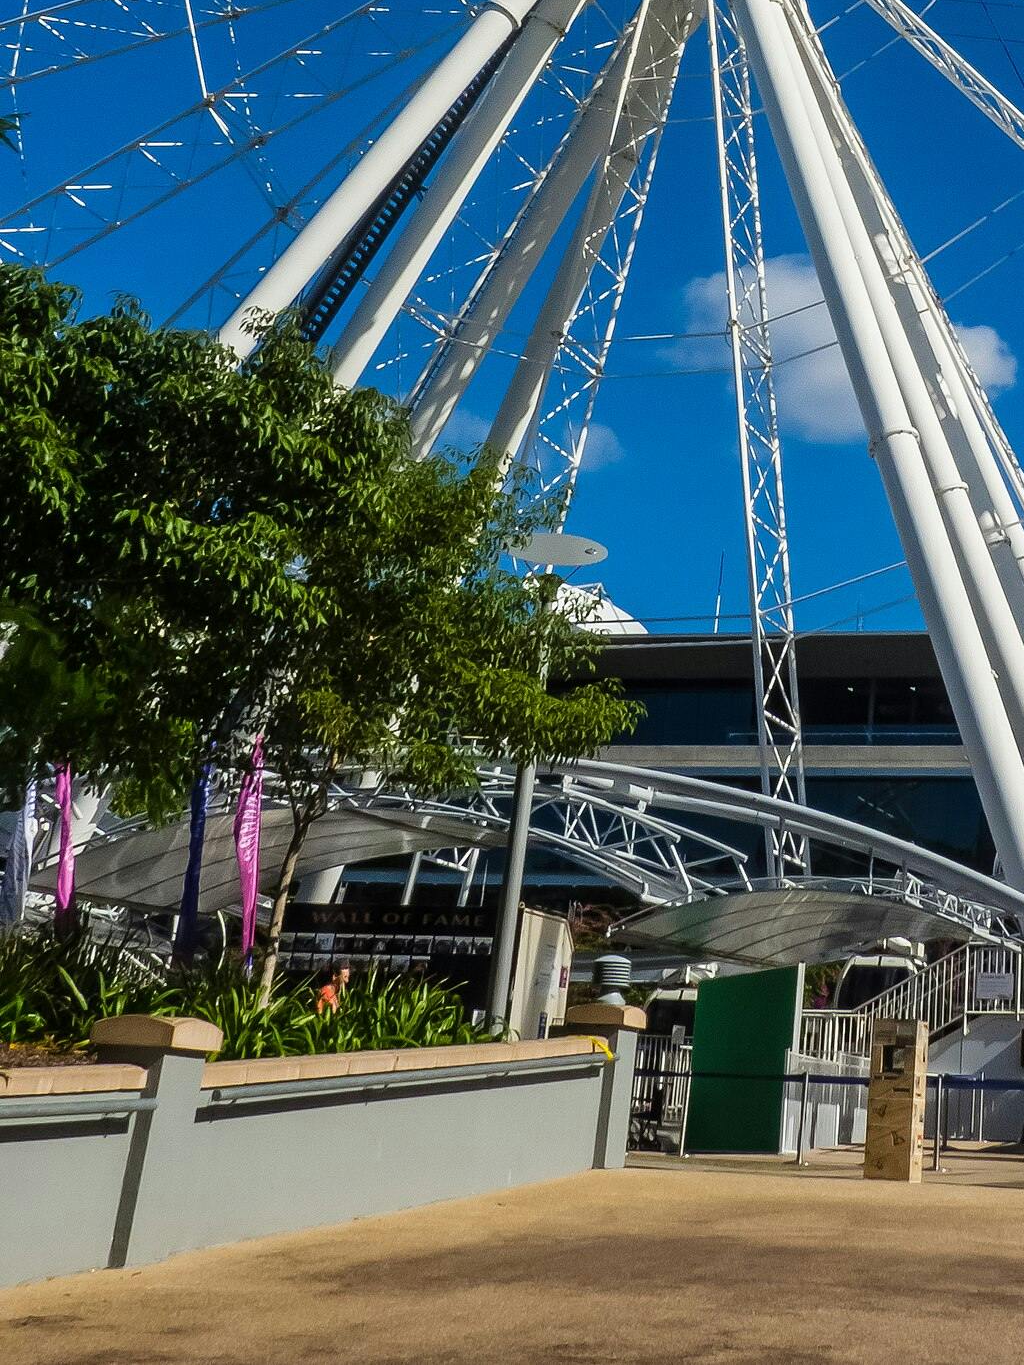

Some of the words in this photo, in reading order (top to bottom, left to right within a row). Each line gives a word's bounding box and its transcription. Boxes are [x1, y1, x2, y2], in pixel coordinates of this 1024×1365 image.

[311, 911, 375, 925] WALL
[382, 912, 414, 925] OF
[421, 912, 485, 927] FAME
